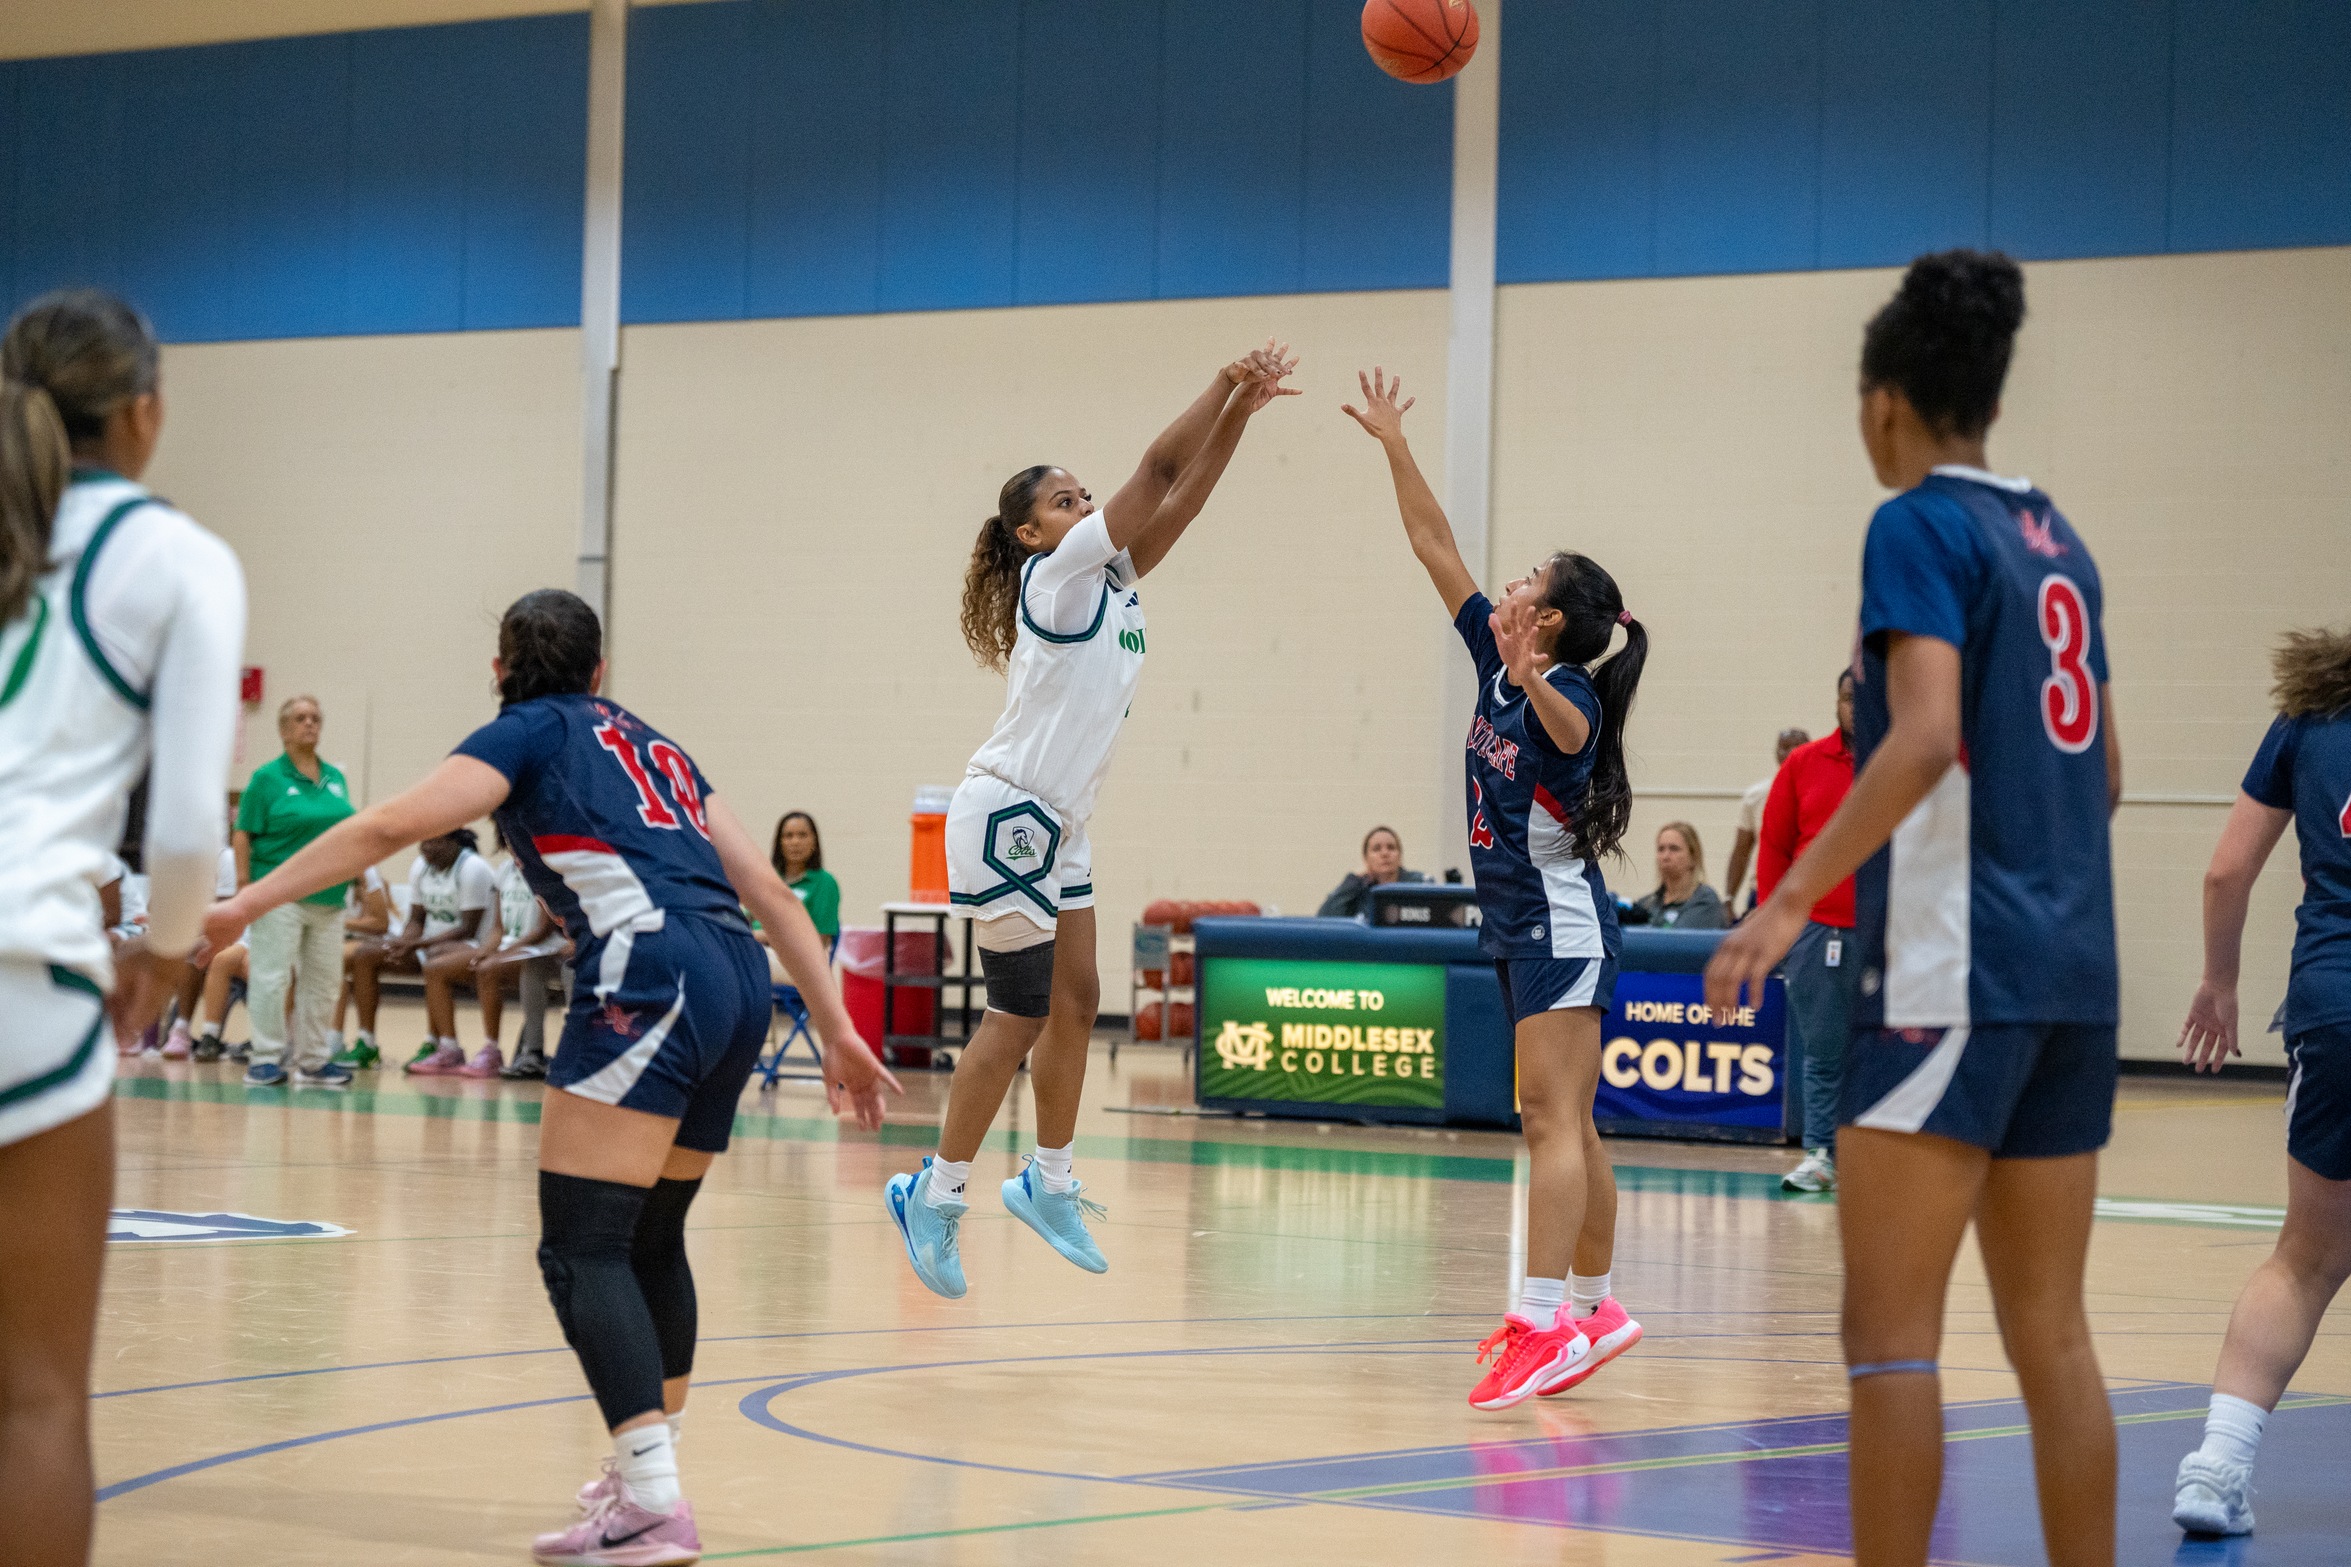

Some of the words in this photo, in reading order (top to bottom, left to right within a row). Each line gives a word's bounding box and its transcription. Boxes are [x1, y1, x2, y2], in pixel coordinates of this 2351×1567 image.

[2037, 573, 2099, 755] 3
[592, 720, 710, 841] 10
[1265, 987, 1355, 1010] WELCOME
[1357, 990, 1385, 1011] TO
[1625, 1001, 1685, 1024] HOME
[1686, 1003, 1713, 1025] OF
[1281, 1022, 1435, 1054] MIDDLESEX
[1281, 1051, 1435, 1079] COLLEGE
[1602, 1036, 1775, 1096] COLTS
